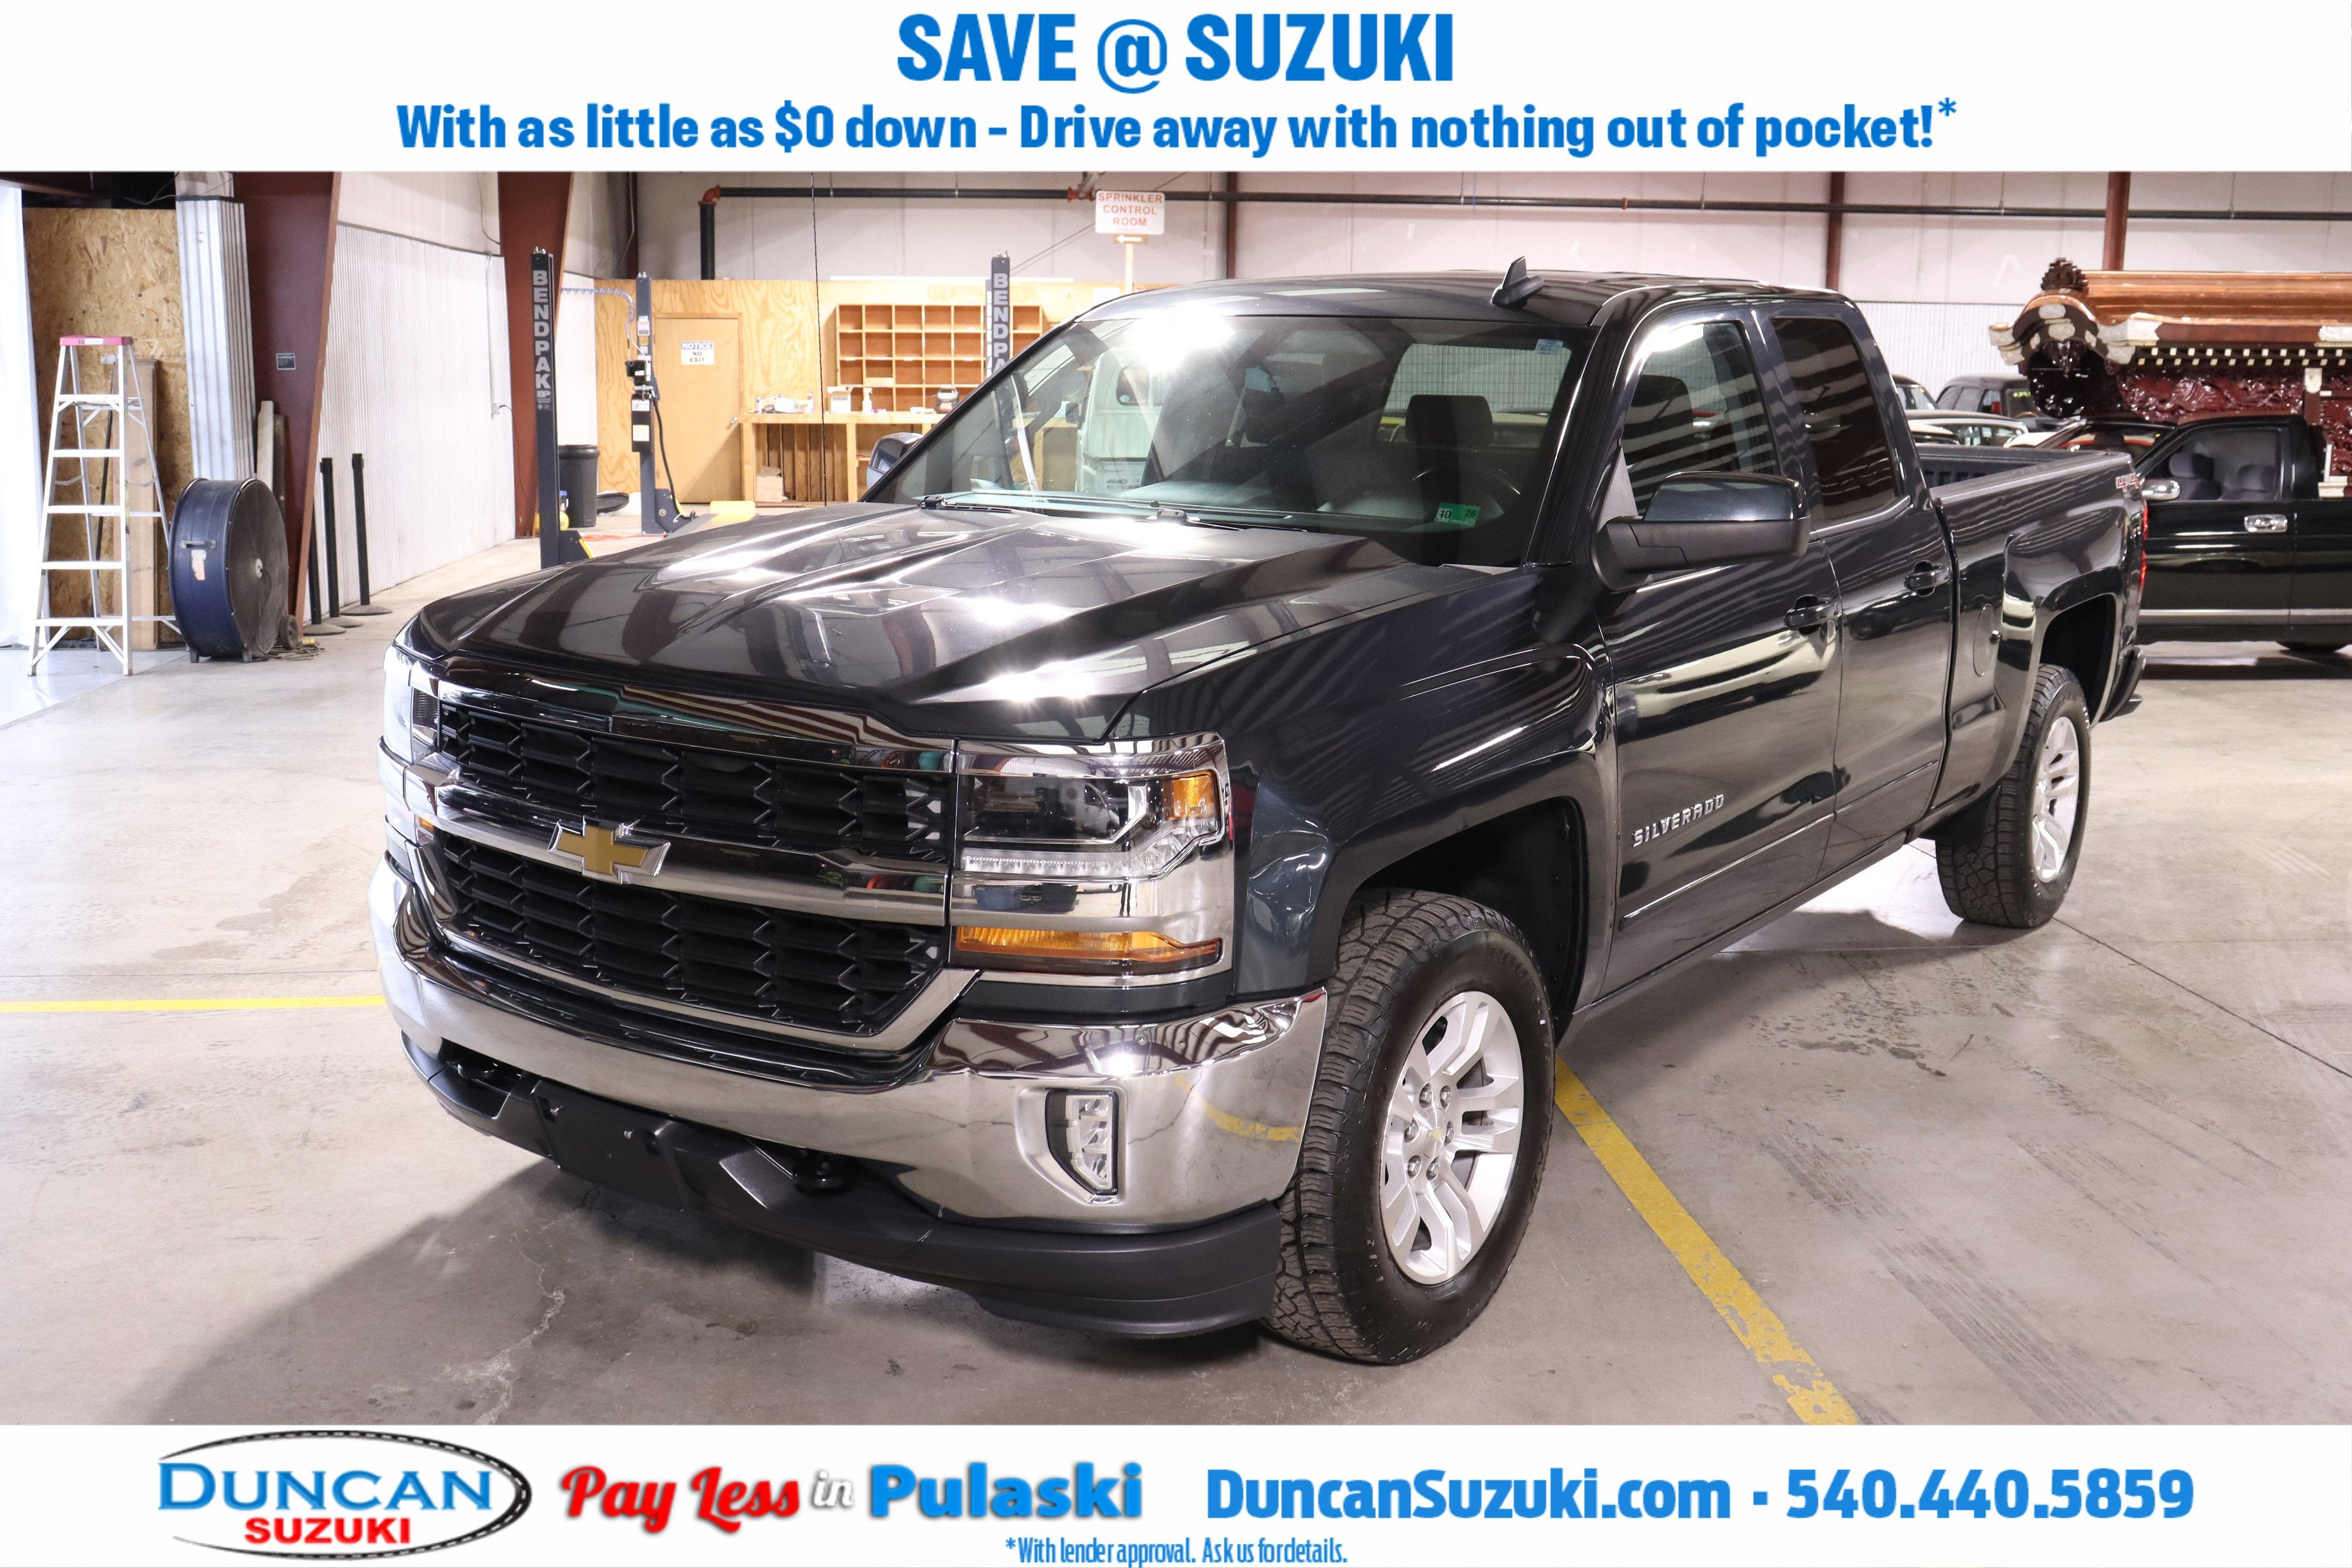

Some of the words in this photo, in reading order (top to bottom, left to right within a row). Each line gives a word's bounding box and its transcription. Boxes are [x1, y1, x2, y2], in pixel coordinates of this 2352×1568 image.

[1099, 193, 1162, 202] SPRINKLER
[1103, 205, 1157, 214] CONTROL
[1113, 217, 1146, 226] ROOM
[533, 270, 551, 388] BENDPAK
[1439, 509, 1452, 519] 10
[1465, 509, 1476, 518] 26
[1632, 794, 1724, 847] SILVERADO
